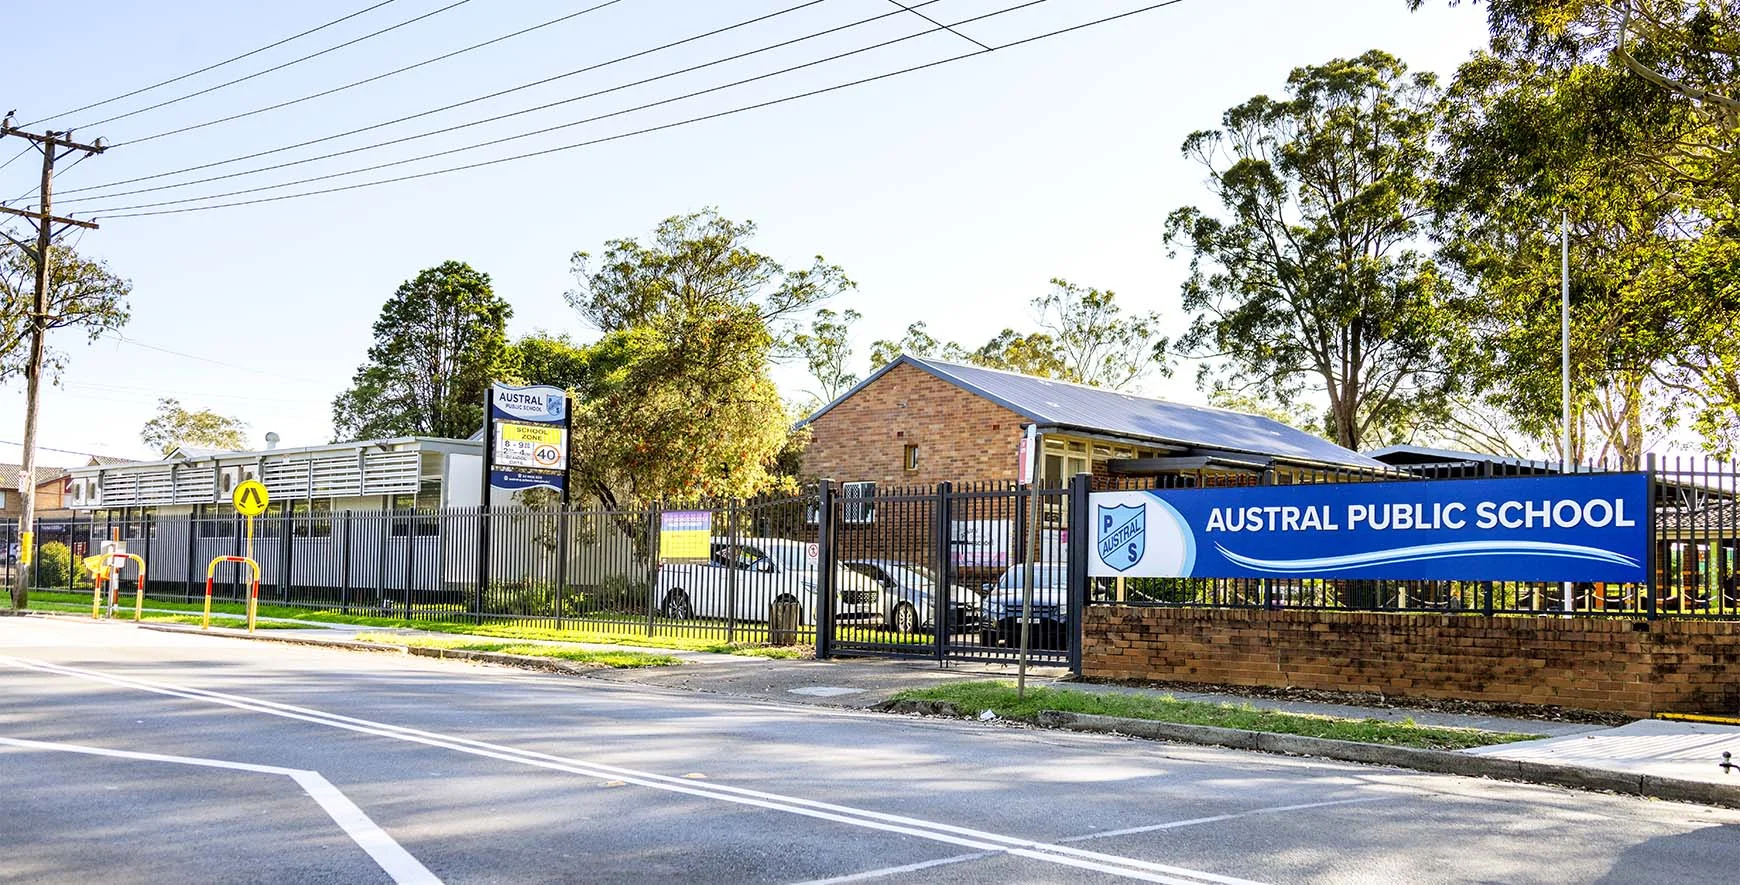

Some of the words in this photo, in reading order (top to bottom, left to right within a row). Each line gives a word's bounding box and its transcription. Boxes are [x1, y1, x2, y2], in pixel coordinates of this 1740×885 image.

[499, 392, 543, 406] AUSTRAL
[523, 405, 543, 413] SCHOOL
[516, 427, 549, 436] SCHOOL
[536, 448, 556, 461] 40
[1103, 514, 1113, 533] P
[1206, 505, 1339, 533] AUSTRAL
[1348, 502, 1467, 531] PUBLIC
[1475, 498, 1636, 529] SCHOOL
[1102, 518, 1141, 556] AUSTRAL
[1127, 542, 1138, 563] S
